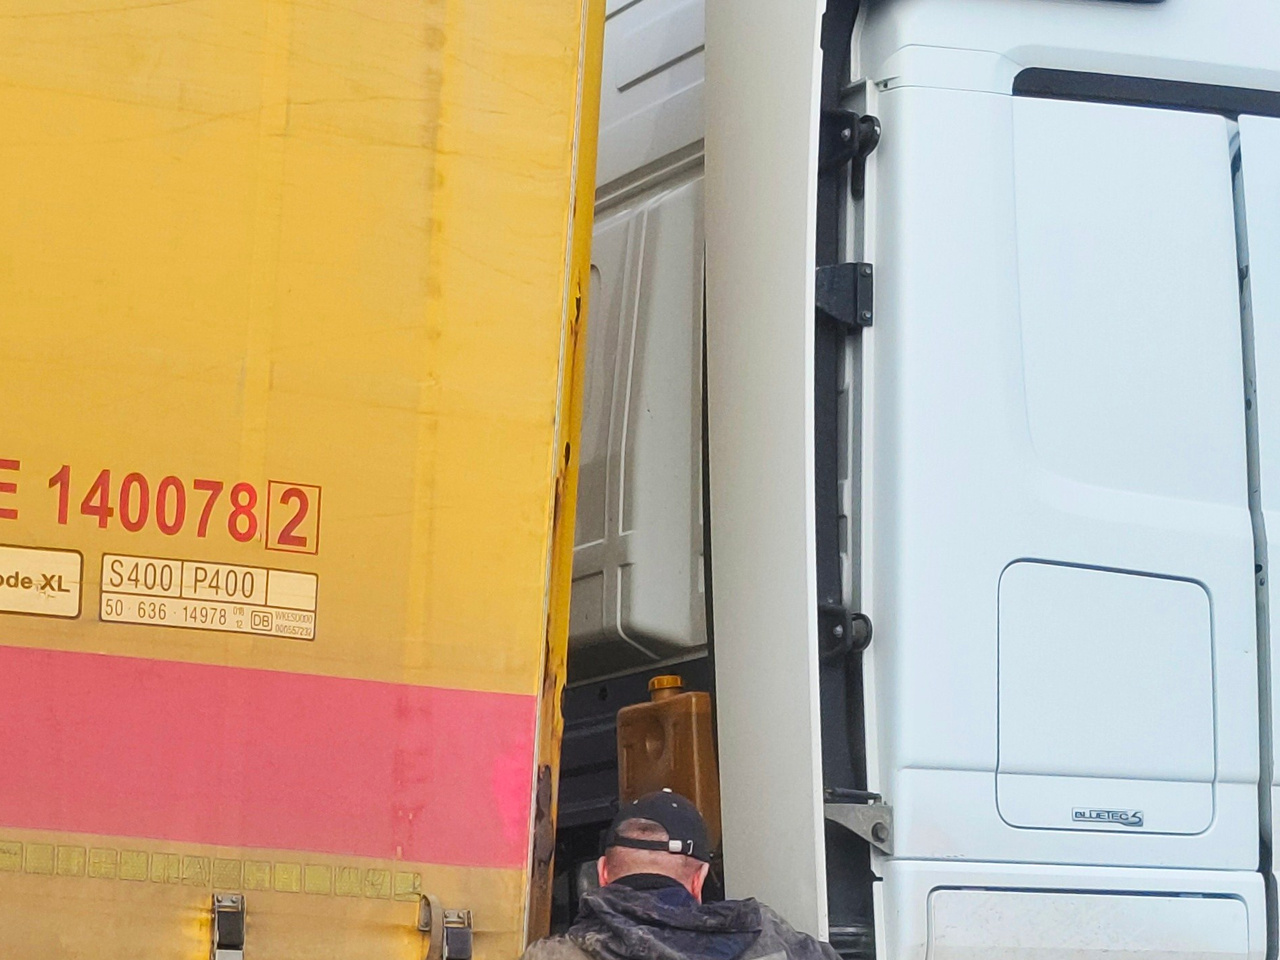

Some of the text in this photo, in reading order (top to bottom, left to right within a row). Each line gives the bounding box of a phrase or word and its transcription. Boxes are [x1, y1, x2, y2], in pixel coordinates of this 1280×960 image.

[48, 464, 258, 543] 140078
[277, 487, 310, 547] 2
[40, 573, 71, 593] XL
[109, 559, 173, 591] S400
[193, 566, 255, 599] P400
[105, 599, 227, 626] 50 636 14978
[253, 614, 270, 627] DB
